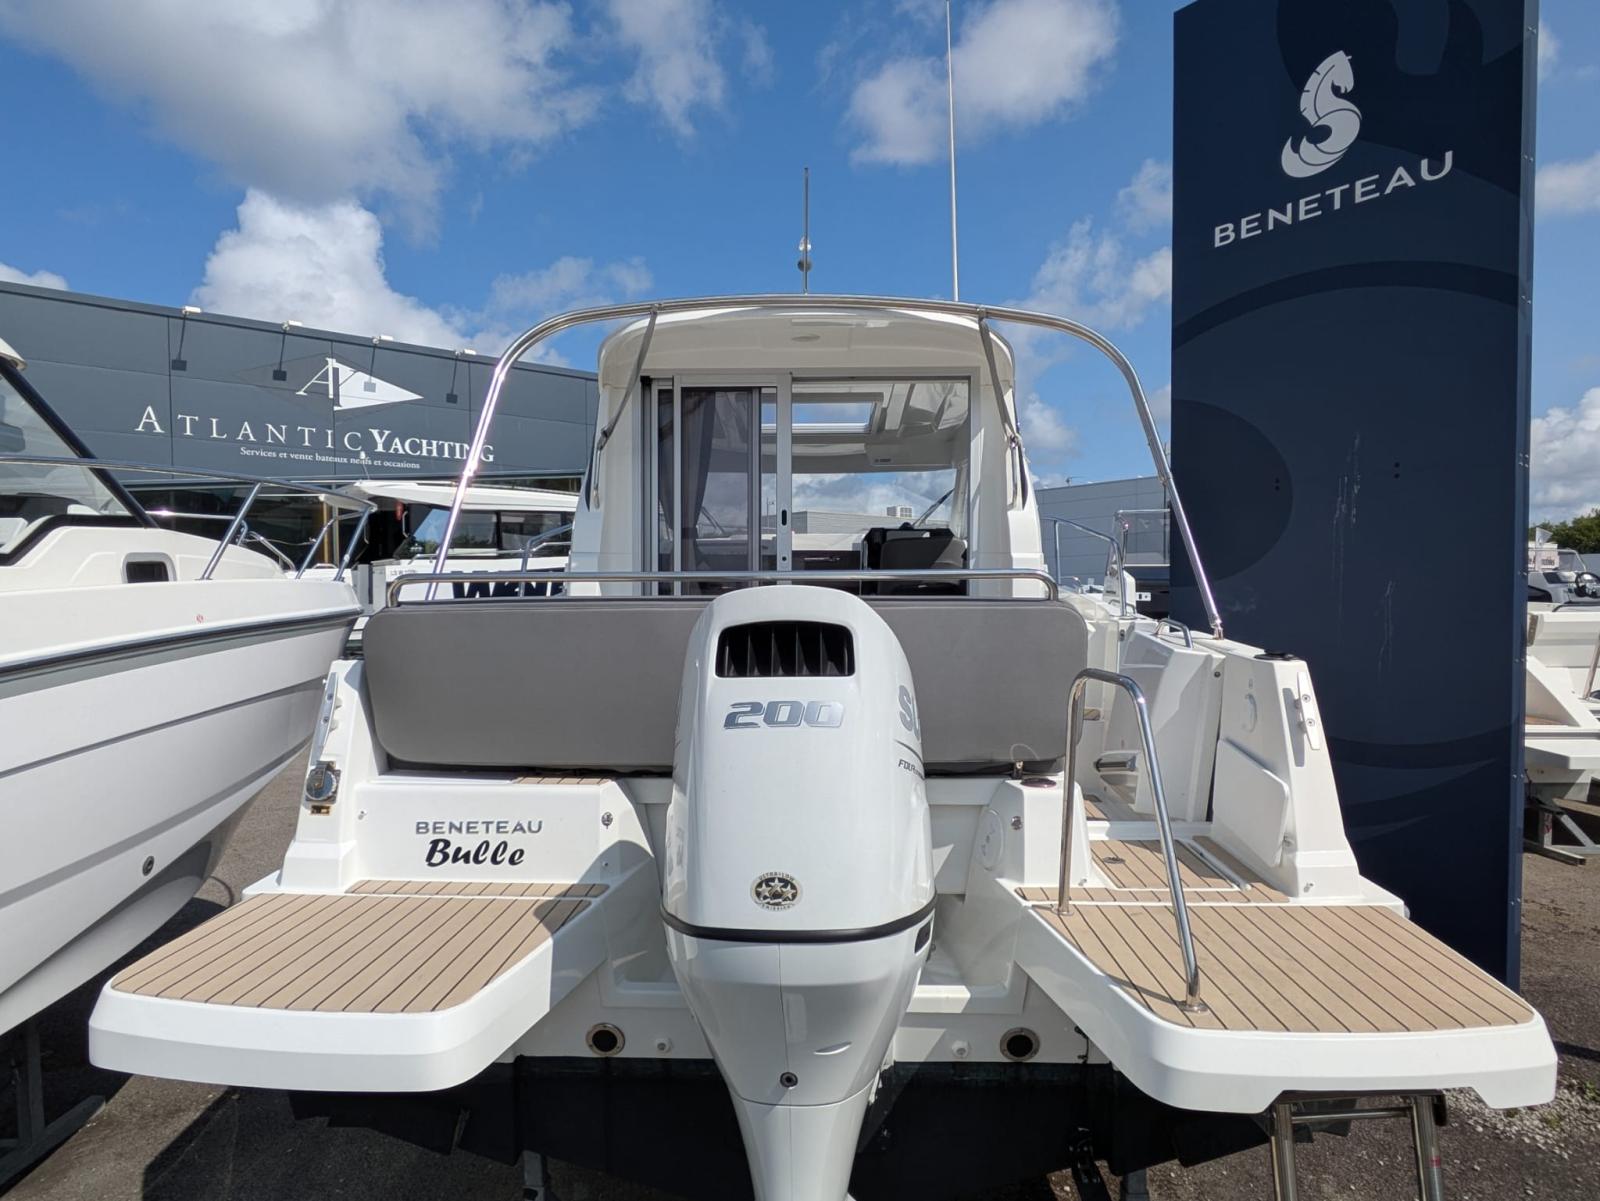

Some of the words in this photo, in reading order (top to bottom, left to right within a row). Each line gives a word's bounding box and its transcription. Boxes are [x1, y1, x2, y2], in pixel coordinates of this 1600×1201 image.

[1214, 150, 1454, 248] BENETEAU
[134, 405, 362, 452] ATLANTIC
[240, 446, 277, 458] Services
[278, 450, 288, 459] et
[289, 453, 314, 461] vente
[315, 453, 348, 464] bateaux
[373, 459, 382, 467] et
[383, 460, 420, 469] occasions
[723, 700, 846, 730] 200
[416, 820, 543, 834] BENETEAU
[425, 838, 525, 867] Bulle
